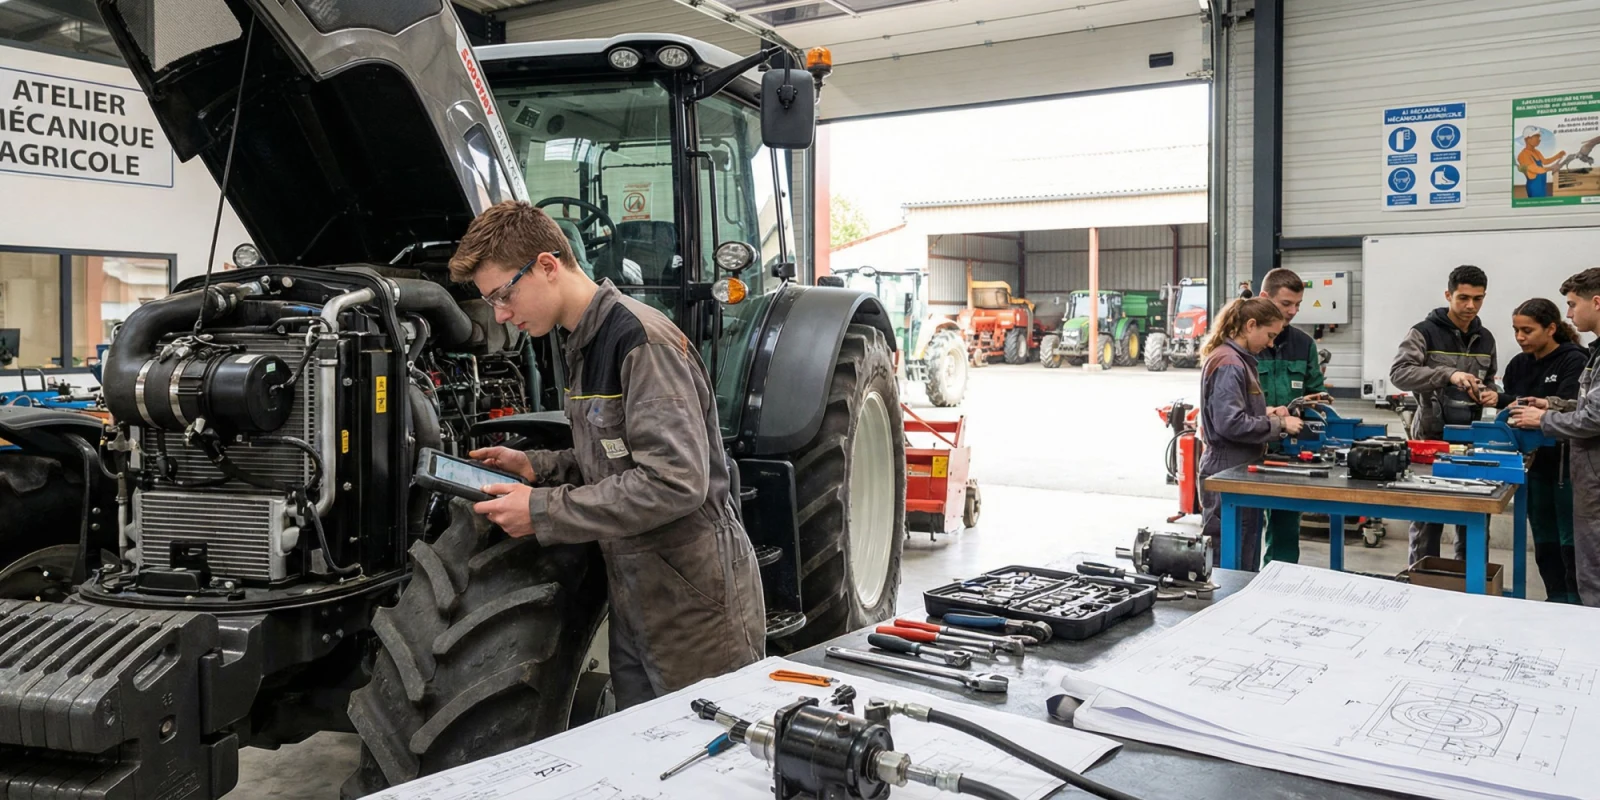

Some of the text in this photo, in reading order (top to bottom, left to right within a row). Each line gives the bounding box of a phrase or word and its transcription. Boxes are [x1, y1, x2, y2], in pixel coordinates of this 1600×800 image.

[12, 79, 126, 116] ATELIER
[0, 105, 154, 149] ÉCANIQUE
[0, 140, 140, 176] AGRICOLE
